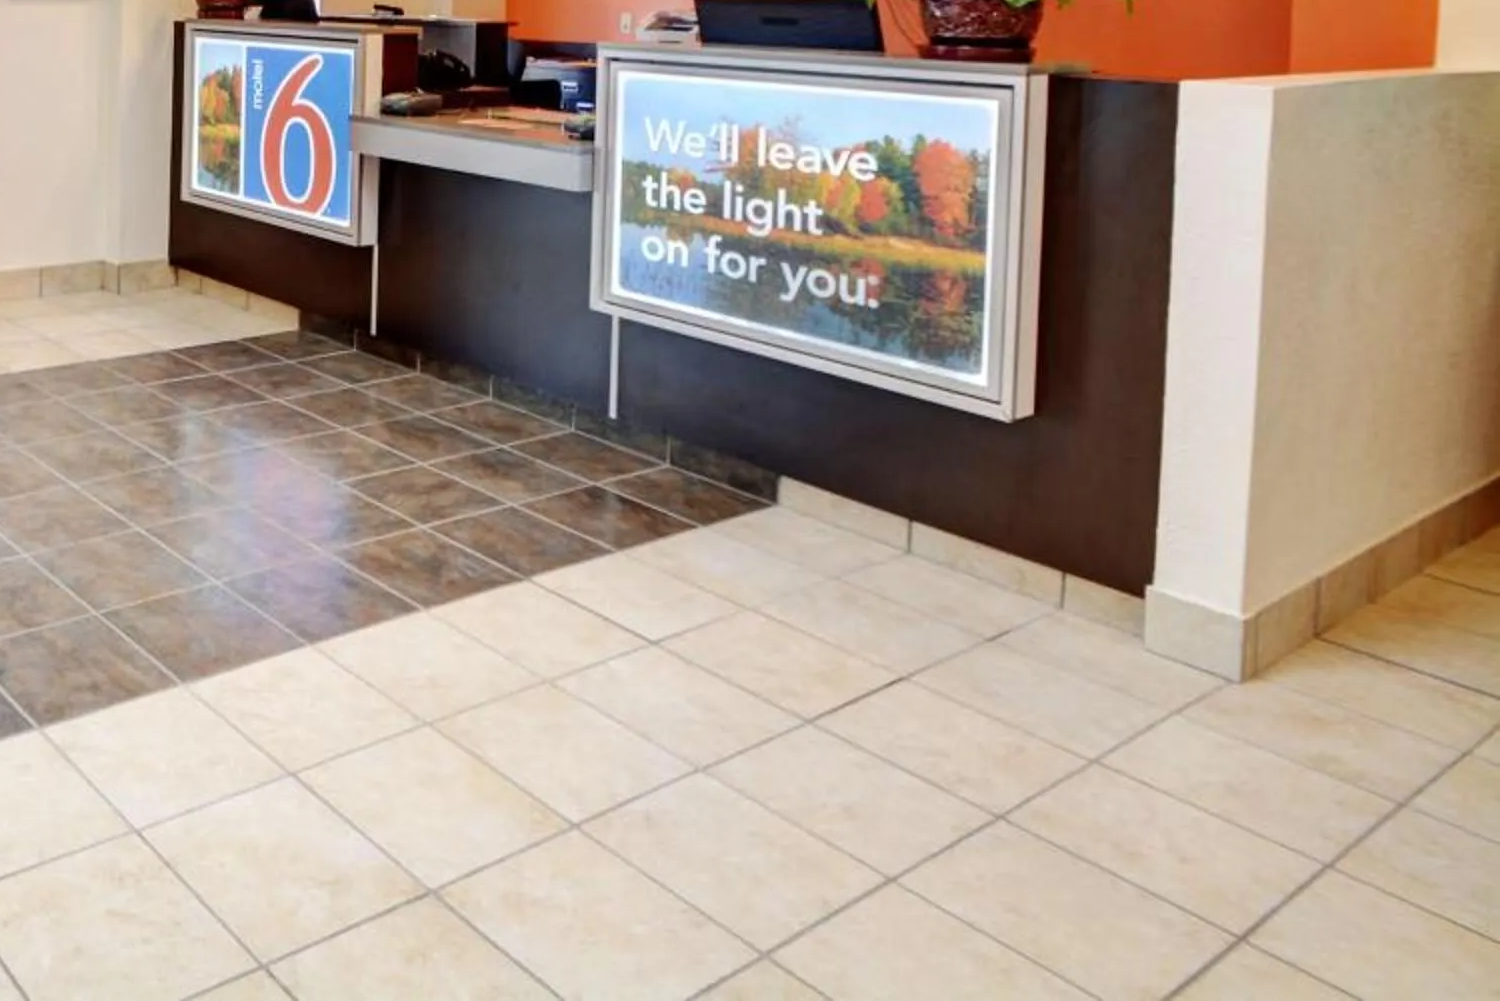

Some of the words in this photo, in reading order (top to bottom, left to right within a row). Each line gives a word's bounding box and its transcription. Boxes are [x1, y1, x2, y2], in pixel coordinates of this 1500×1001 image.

[251, 59, 264, 109] motel
[260, 54, 336, 216] 6
[757, 126, 879, 182] leave
[642, 172, 707, 215] the
[723, 181, 824, 238] light
[641, 235, 688, 268] on
[705, 239, 767, 283] for
